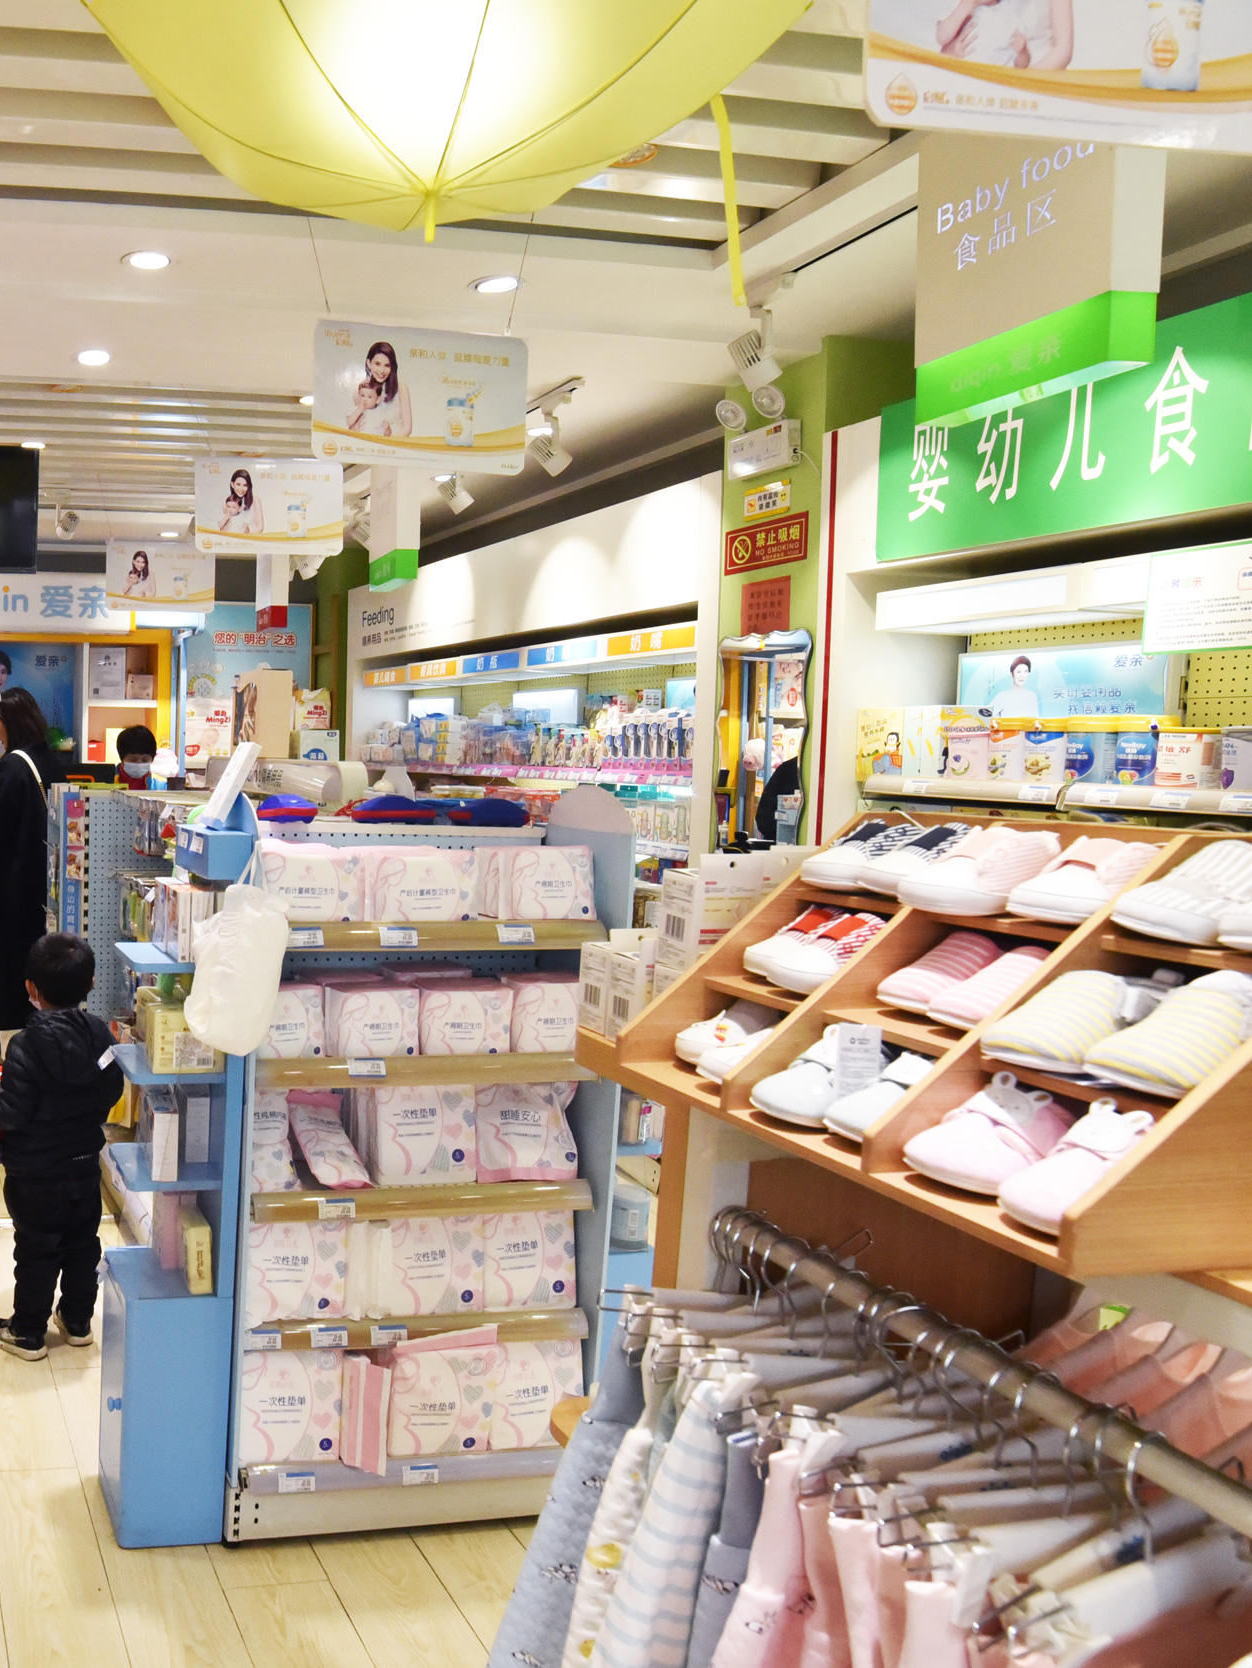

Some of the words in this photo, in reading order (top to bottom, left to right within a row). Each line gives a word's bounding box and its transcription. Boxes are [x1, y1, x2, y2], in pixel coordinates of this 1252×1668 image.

[936, 177, 1010, 236] Baby
[953, 189, 1057, 271] 食品区
[1007, 333, 1062, 377] 爱亲
[908, 346, 1252, 522] 婴幼儿食
[755, 524, 800, 548] 禁止吸烟
[767, 542, 800, 554] SMOKING
[40, 584, 109, 619] 爱亲
[361, 607, 395, 628] Feeding
[629, 631, 663, 653] 奶嘴
[34, 654, 60, 668] 爱亲
[476, 655, 499, 671] 奶瓶
[1113, 653, 1144, 668] 爱亲
[206, 715, 232, 724] MingZi
[393, 1108, 438, 1120] 一次性垫单
[499, 1109, 541, 1122] 甜睡安心
[496, 1240, 539, 1252] 一次性垫单
[262, 1255, 310, 1267] 一次性垫单
[404, 1249, 447, 1263] 一次性垫单
[506, 1384, 550, 1399] 一次性垫单
[258, 1396, 306, 1407] 一次性垫单
[410, 1401, 456, 1412] 一次性垫单
